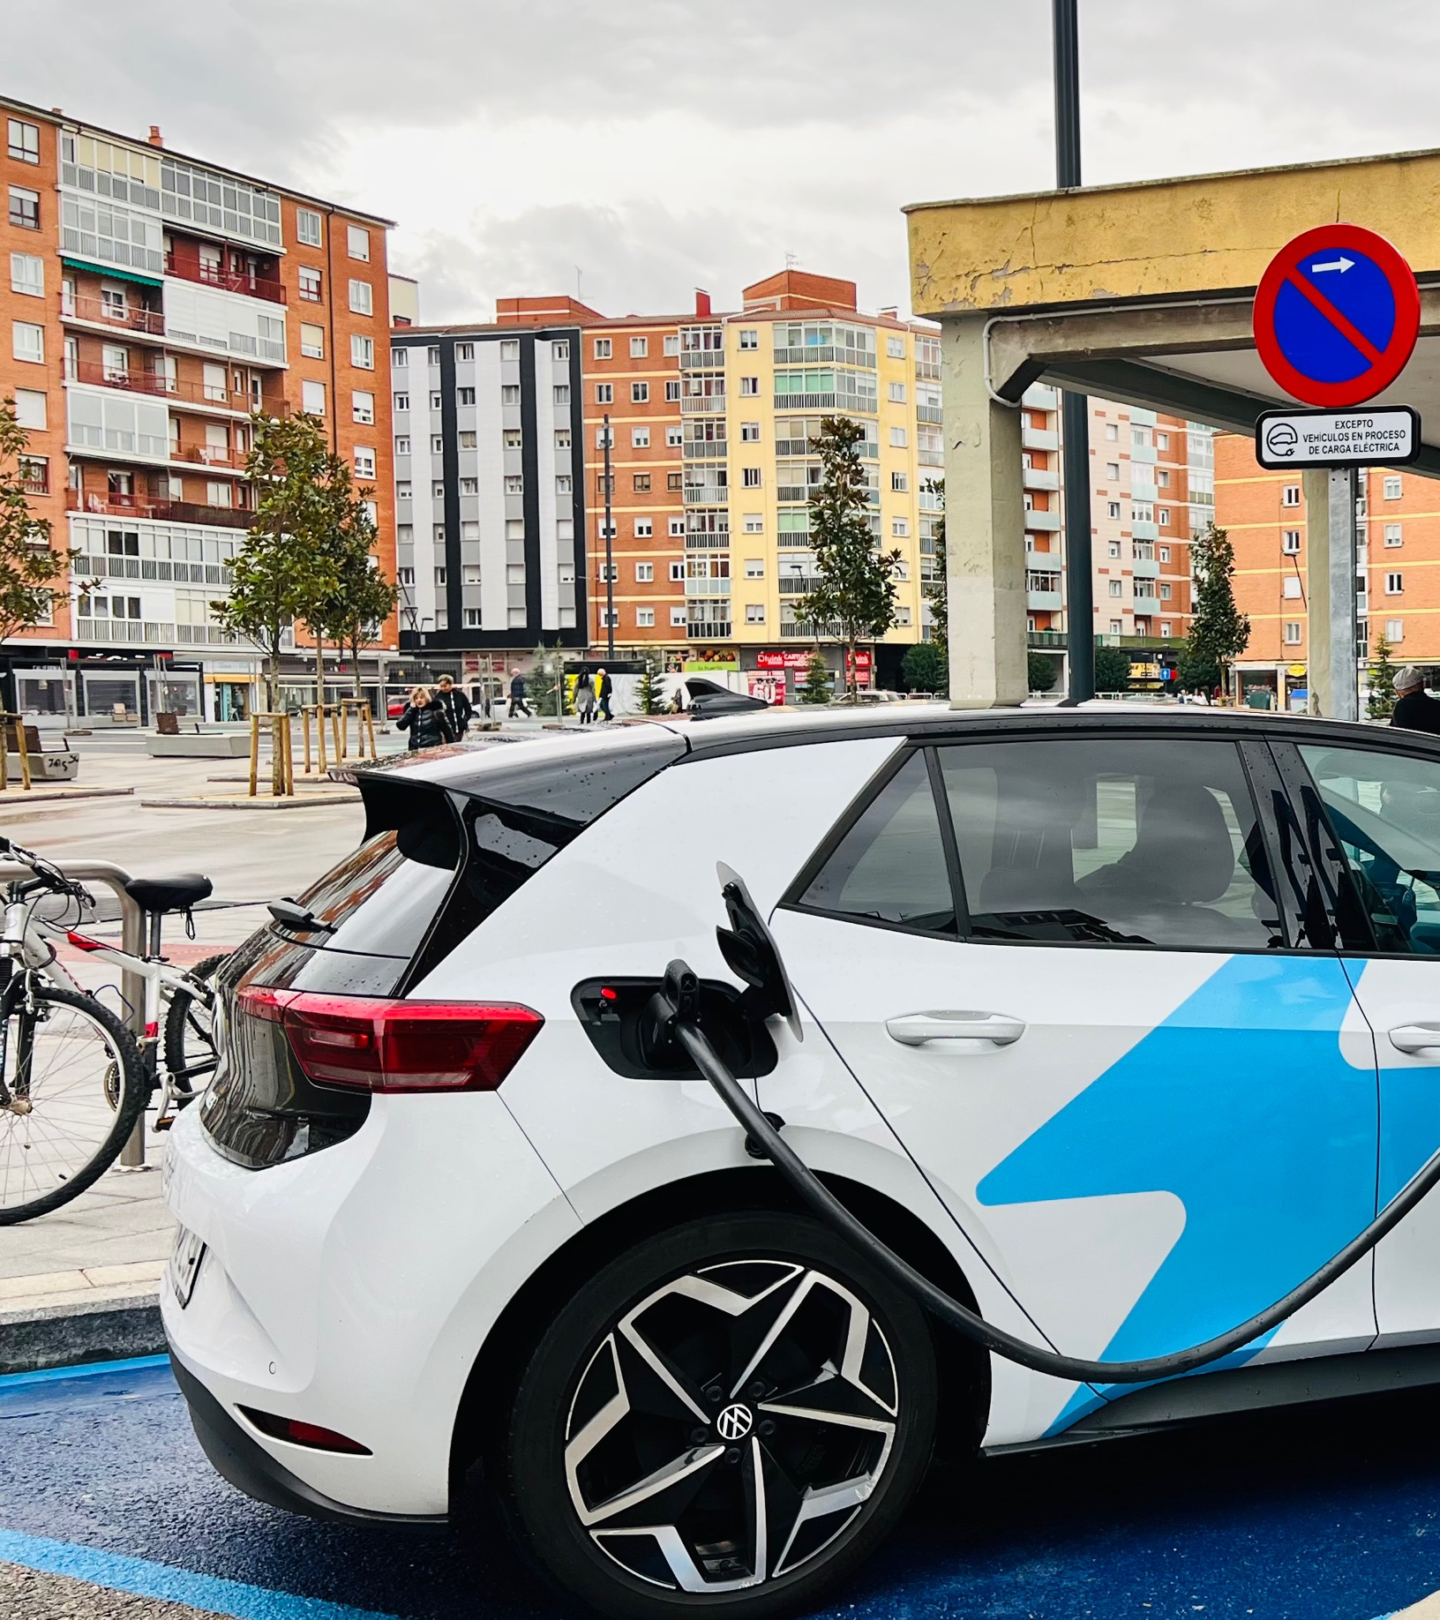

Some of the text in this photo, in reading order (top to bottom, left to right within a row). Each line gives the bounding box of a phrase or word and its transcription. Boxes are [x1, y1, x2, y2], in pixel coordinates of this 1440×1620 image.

[1334, 419, 1374, 430] EXCEPTO
[1302, 430, 1406, 443] VEHÍCULOS EN PROCESO
[1308, 442, 1400, 455] DE CARGA ELÉCTRICA
